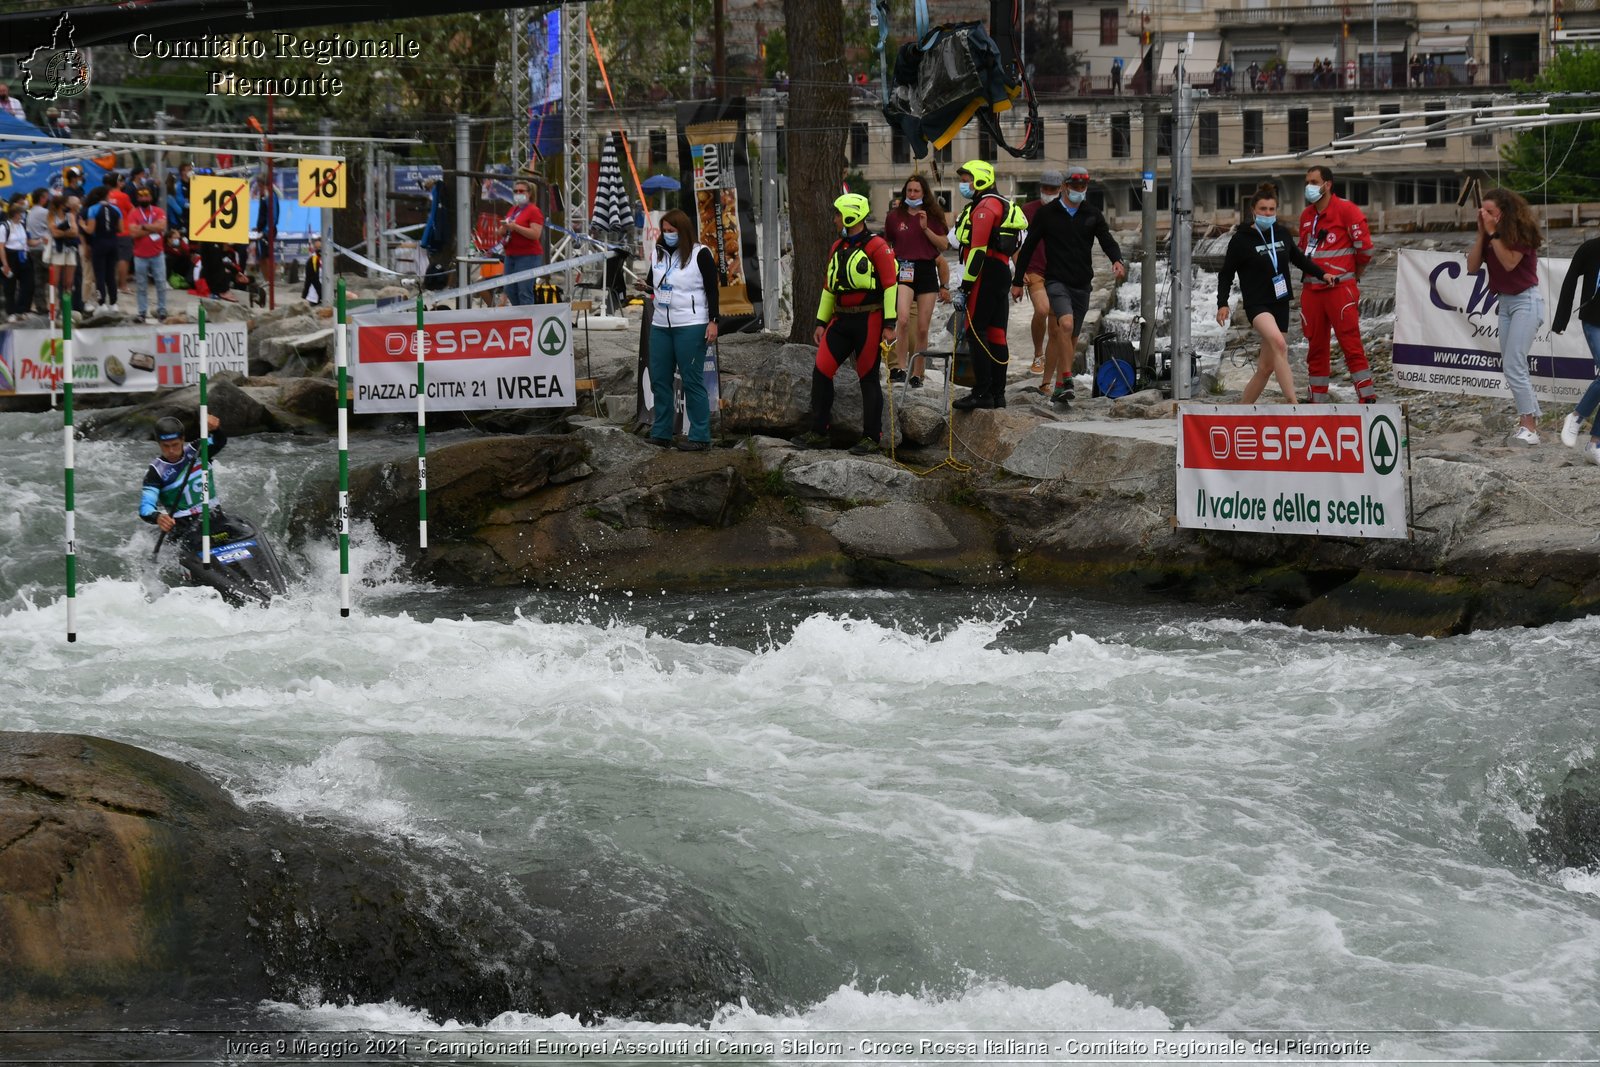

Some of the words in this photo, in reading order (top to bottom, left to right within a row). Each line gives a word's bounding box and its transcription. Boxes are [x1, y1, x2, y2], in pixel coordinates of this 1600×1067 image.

[704, 143, 720, 189] KIND
[308, 168, 338, 199] 18
[202, 189, 238, 230] 19
[385, 325, 531, 355] DESPAR
[358, 383, 405, 400] PIAZZA
[471, 380, 487, 397] 21
[497, 374, 564, 399] IVREA
[1397, 370, 1428, 384] GLOBAL
[1428, 373, 1461, 386] SERVICE
[1461, 376, 1501, 390] PROVIDER
[1551, 385, 1582, 397] LOGISTICA
[1209, 426, 1361, 462] DESPAR
[1209, 489, 1267, 521] valore
[1273, 492, 1321, 523] della
[1327, 494, 1385, 526] scelta
